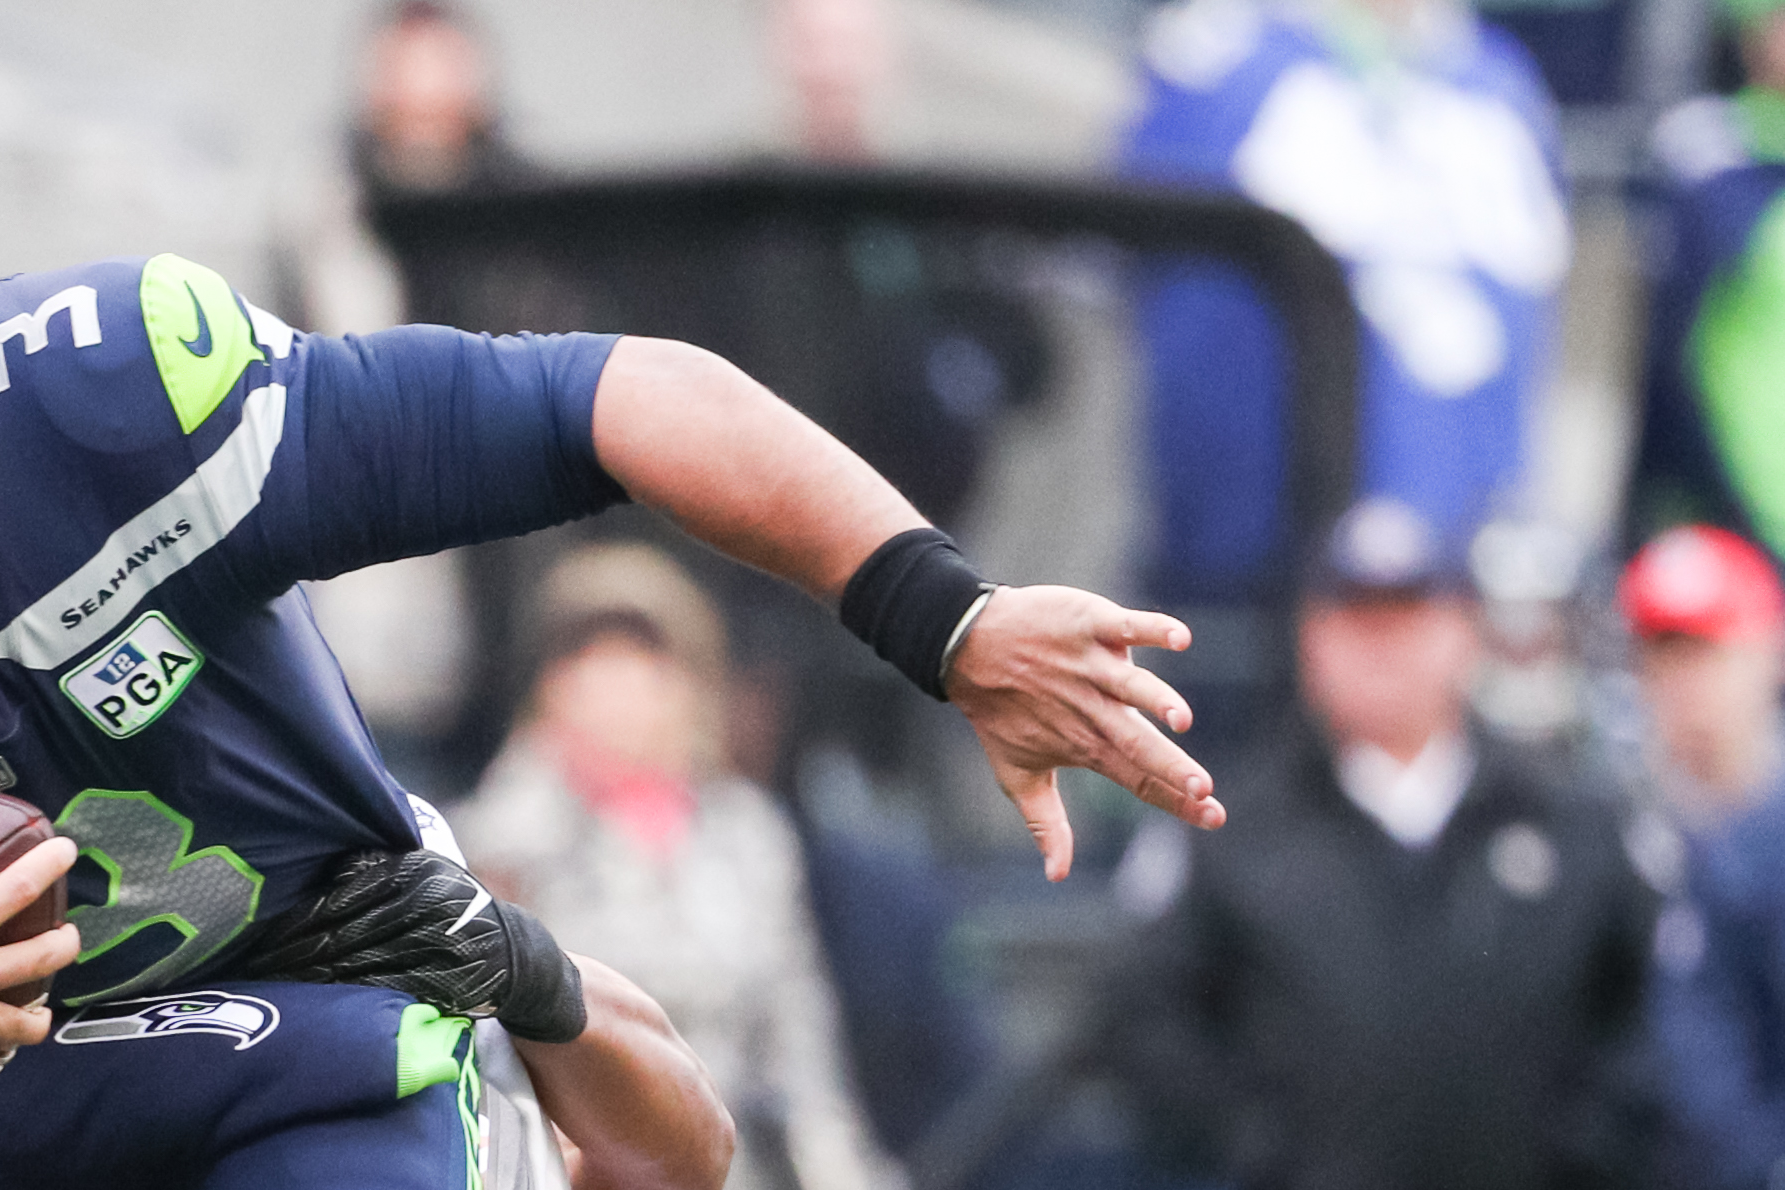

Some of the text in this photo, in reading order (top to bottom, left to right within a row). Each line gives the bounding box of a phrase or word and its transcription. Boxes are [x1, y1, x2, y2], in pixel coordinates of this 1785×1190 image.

[61, 519, 192, 629] SEAHAWKS
[94, 651, 194, 728] PGA
[105, 652, 137, 681] 12
[53, 788, 265, 1007] 3
